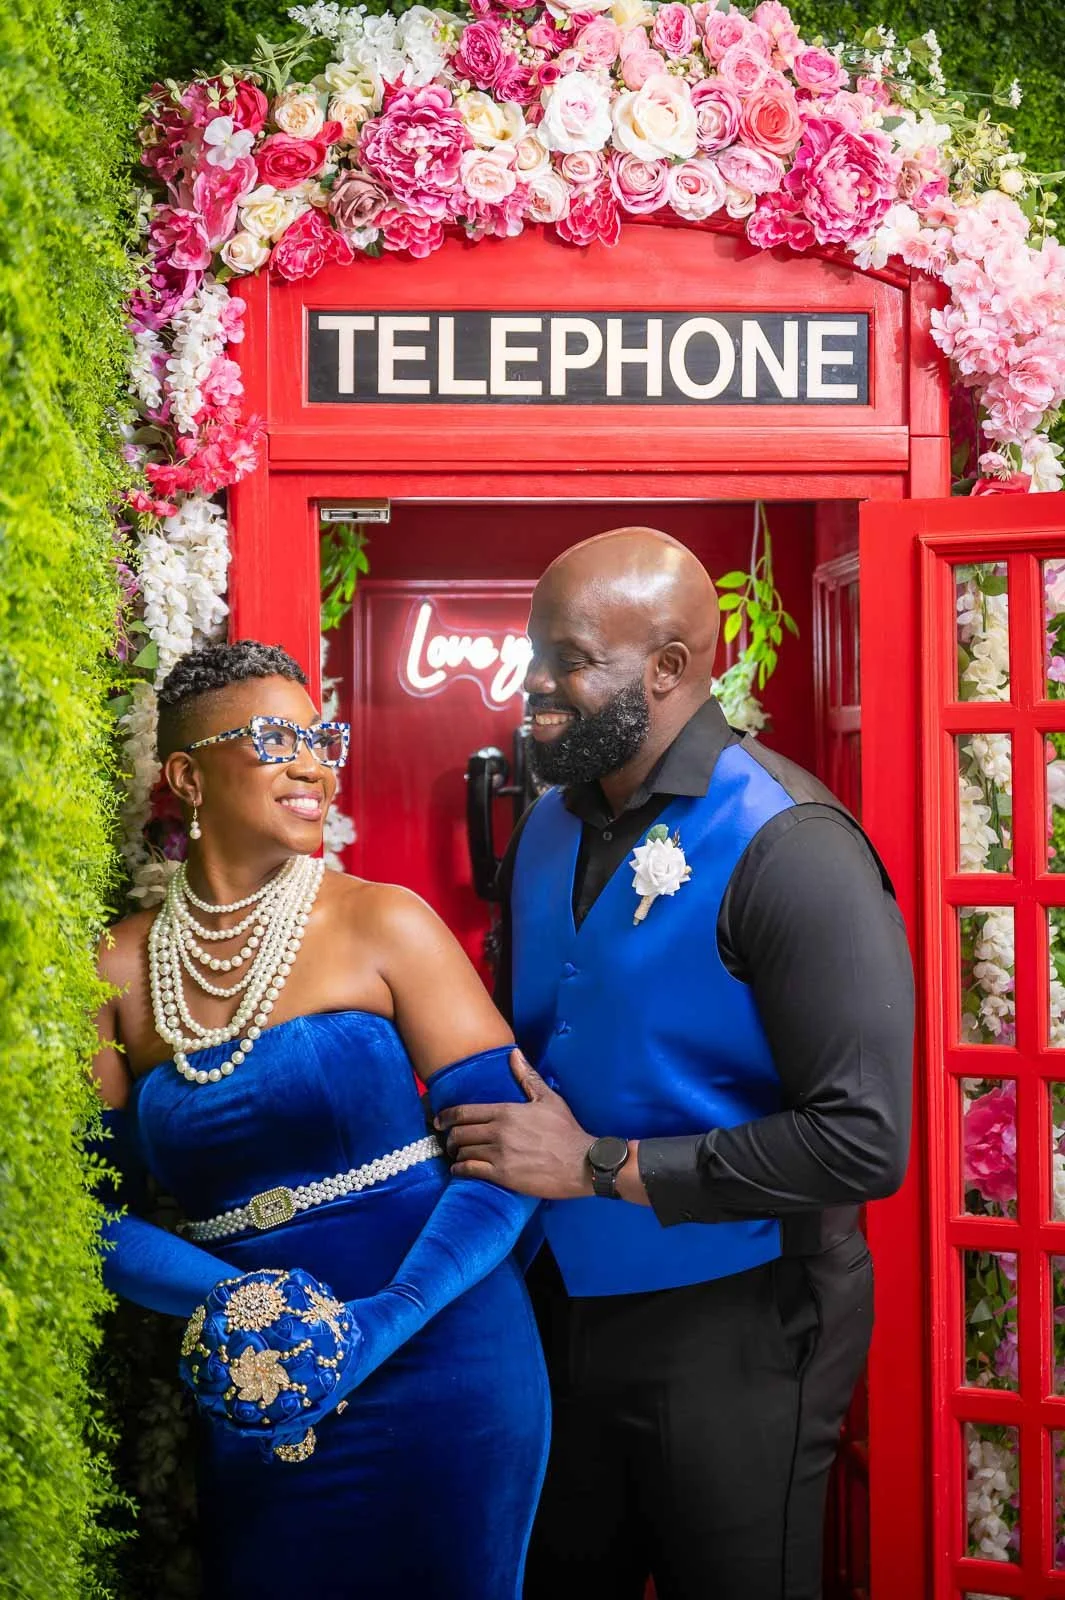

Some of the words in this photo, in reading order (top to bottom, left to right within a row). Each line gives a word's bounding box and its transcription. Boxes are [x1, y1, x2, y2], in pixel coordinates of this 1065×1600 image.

[318, 316, 857, 399] TELEPHONE
[407, 603, 499, 689] Love
[491, 635, 534, 702] y
